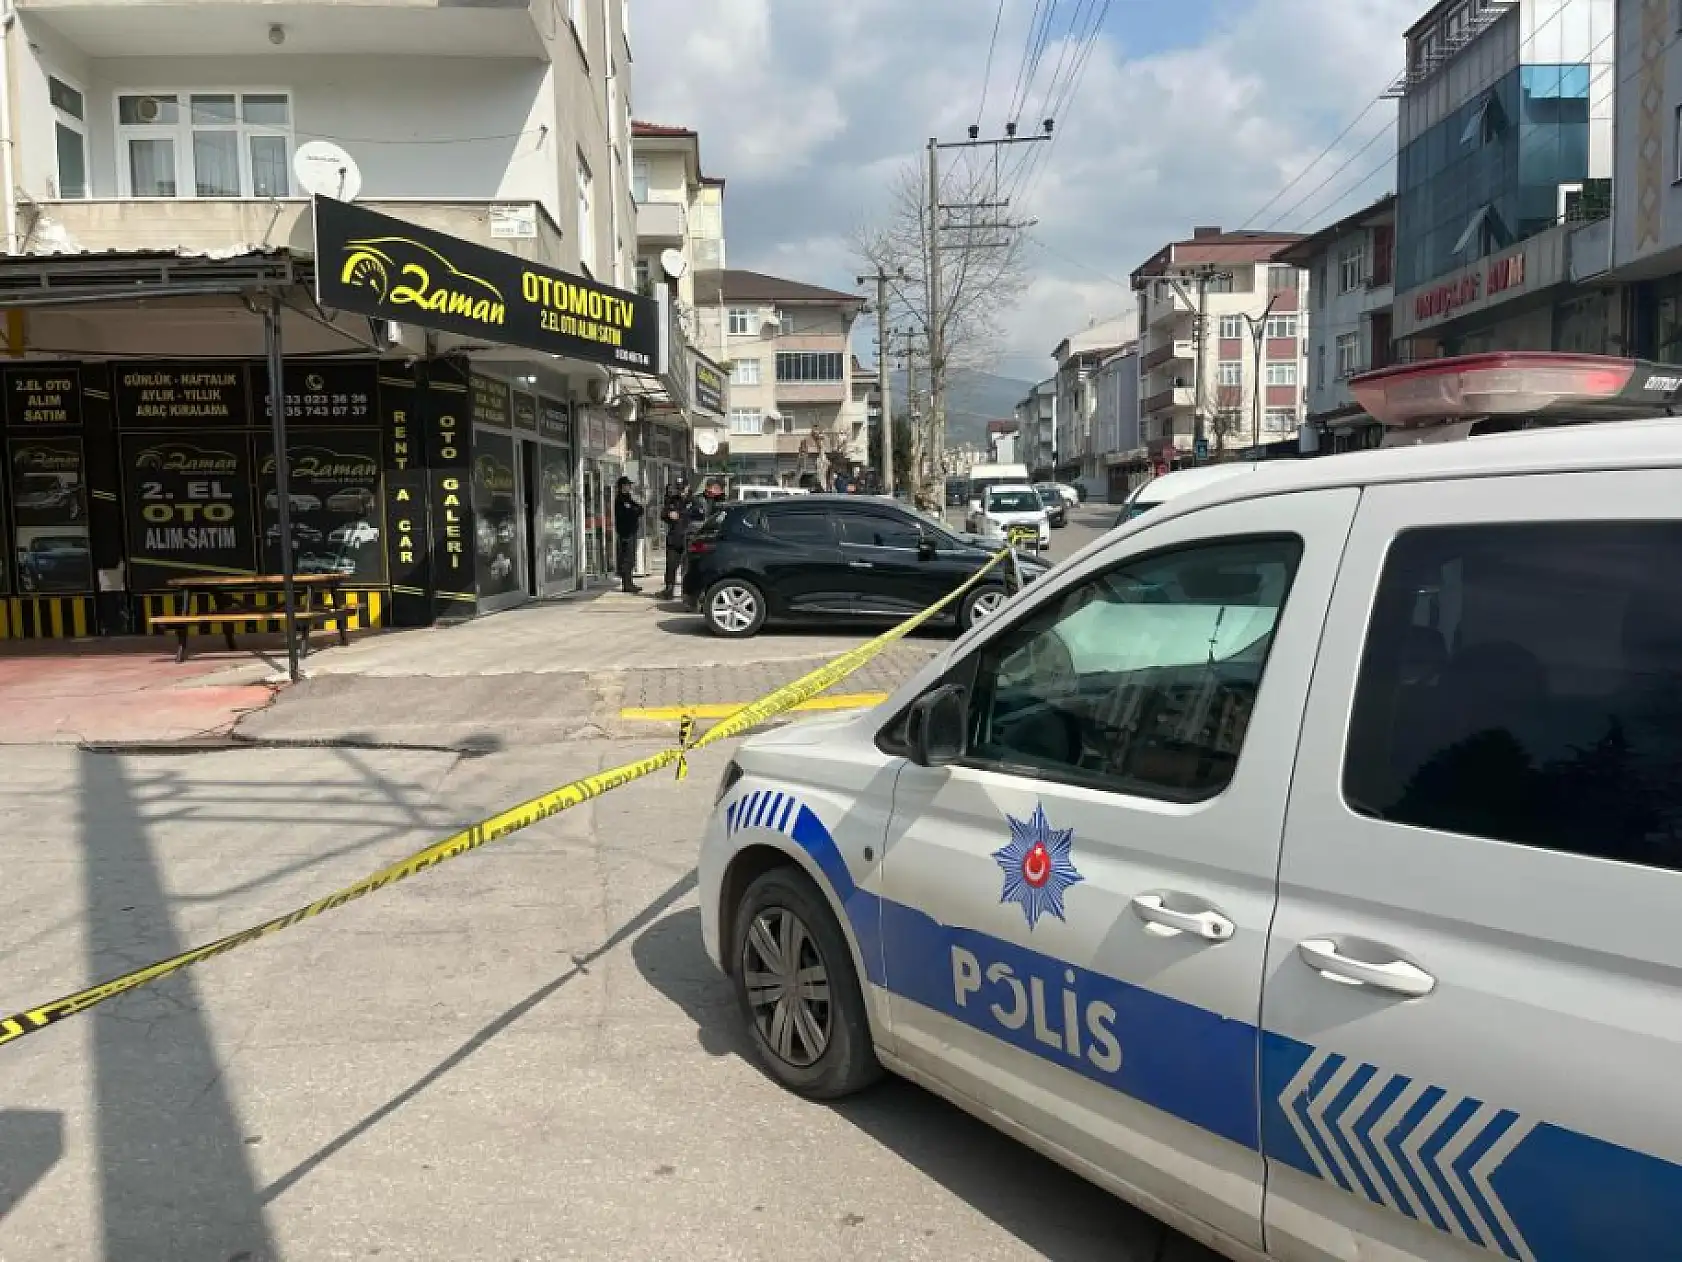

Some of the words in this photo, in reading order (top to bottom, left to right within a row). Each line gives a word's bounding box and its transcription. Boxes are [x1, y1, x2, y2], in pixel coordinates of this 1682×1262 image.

[439, 415, 457, 459] OTO
[142, 481, 174, 500] 2.
[187, 481, 233, 500] EL
[396, 488, 410, 501] A
[142, 503, 235, 522] OTO
[144, 527, 237, 549] ALIM-SATIM
[398, 519, 414, 564] CAR
